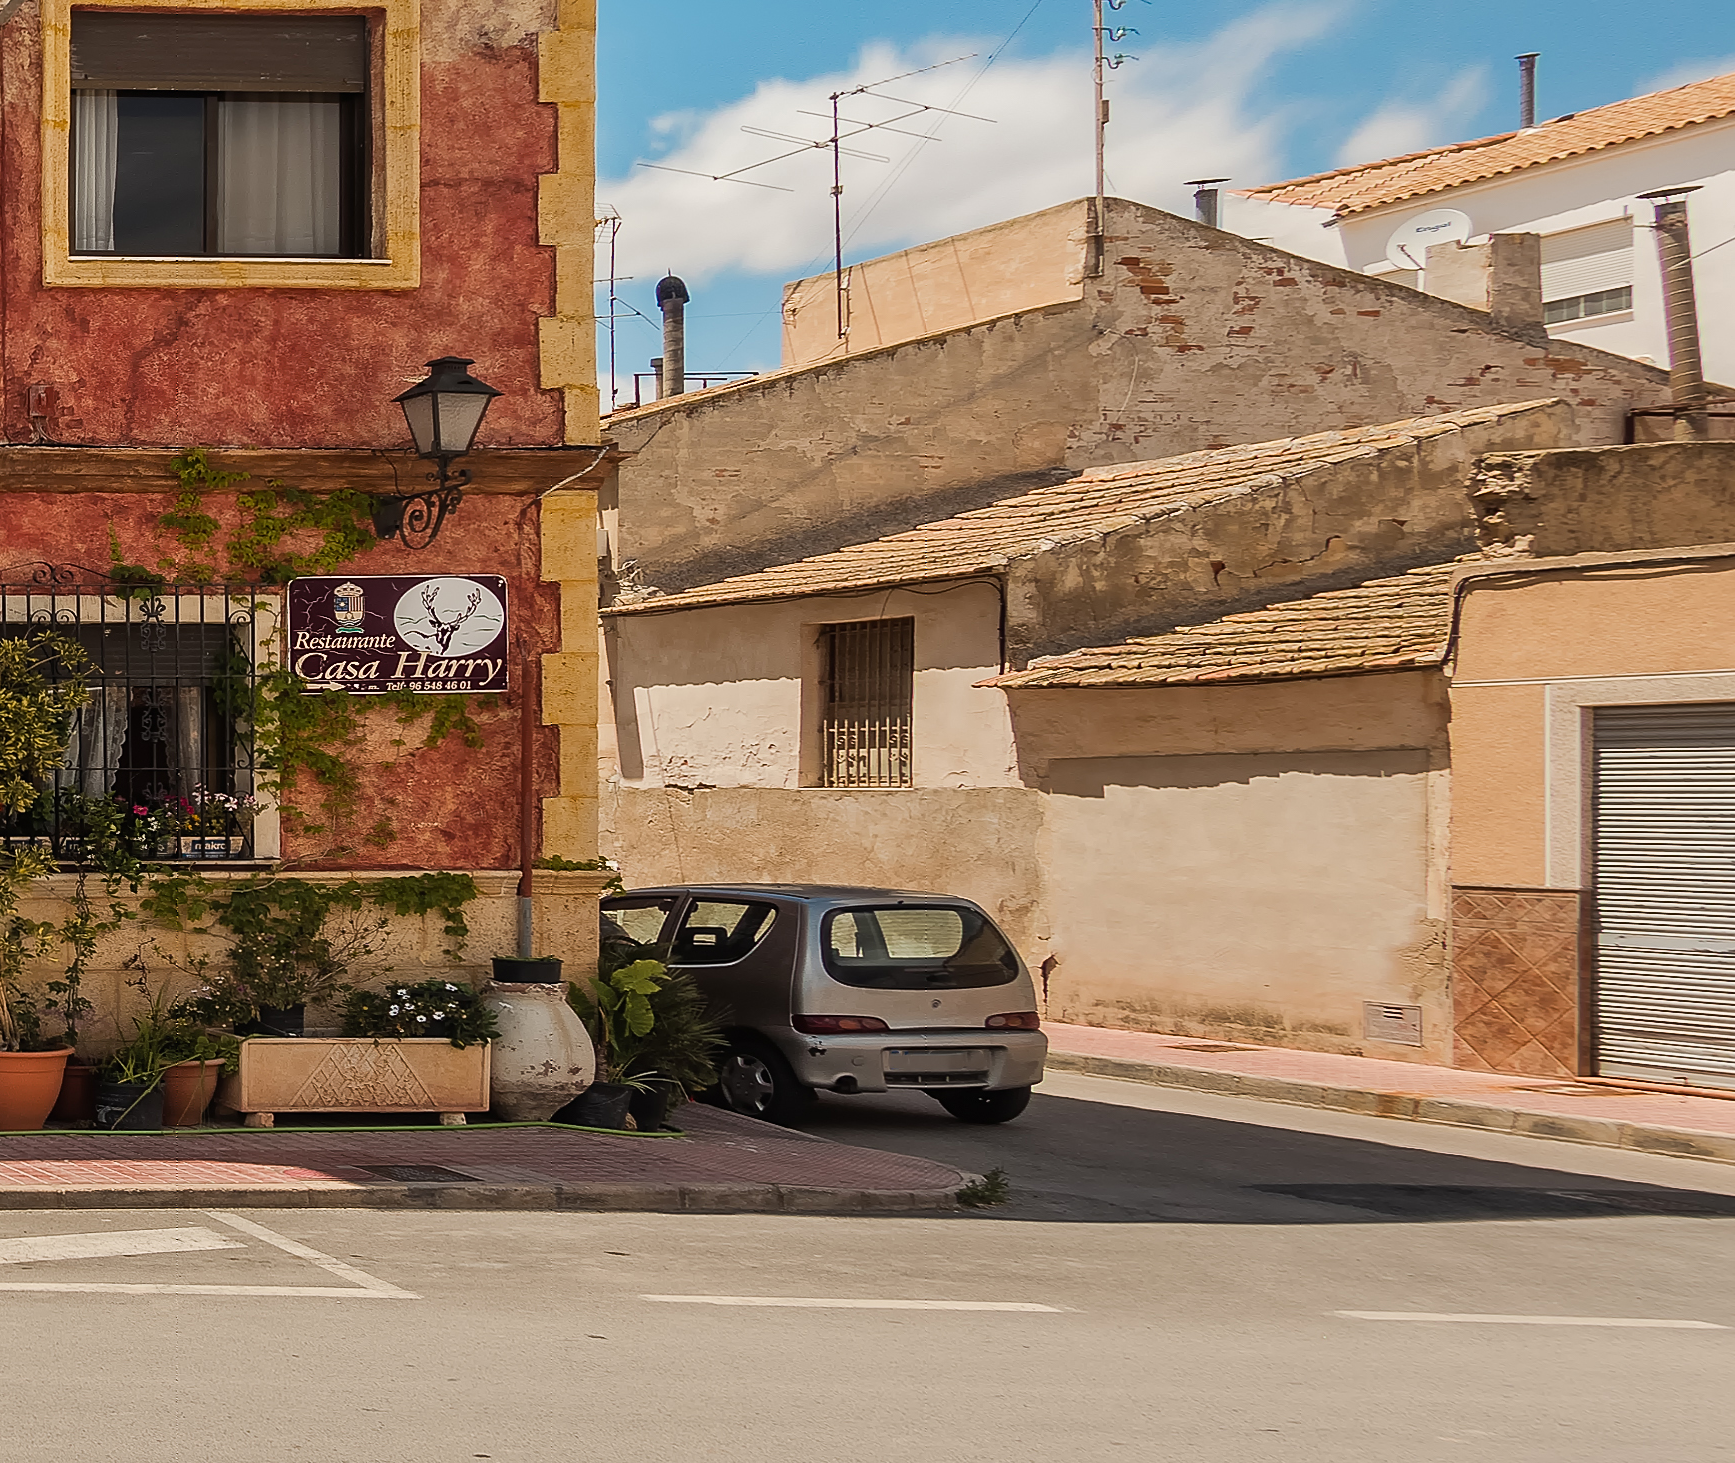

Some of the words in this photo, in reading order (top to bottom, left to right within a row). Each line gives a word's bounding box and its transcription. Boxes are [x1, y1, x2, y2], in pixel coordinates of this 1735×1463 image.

[294, 631, 396, 650] Restaurante
[295, 652, 381, 680] Casa
[391, 651, 502, 686] Harry
[409, 682, 421, 690] 96
[424, 682, 442, 690] 548
[460, 681, 471, 689] 01
